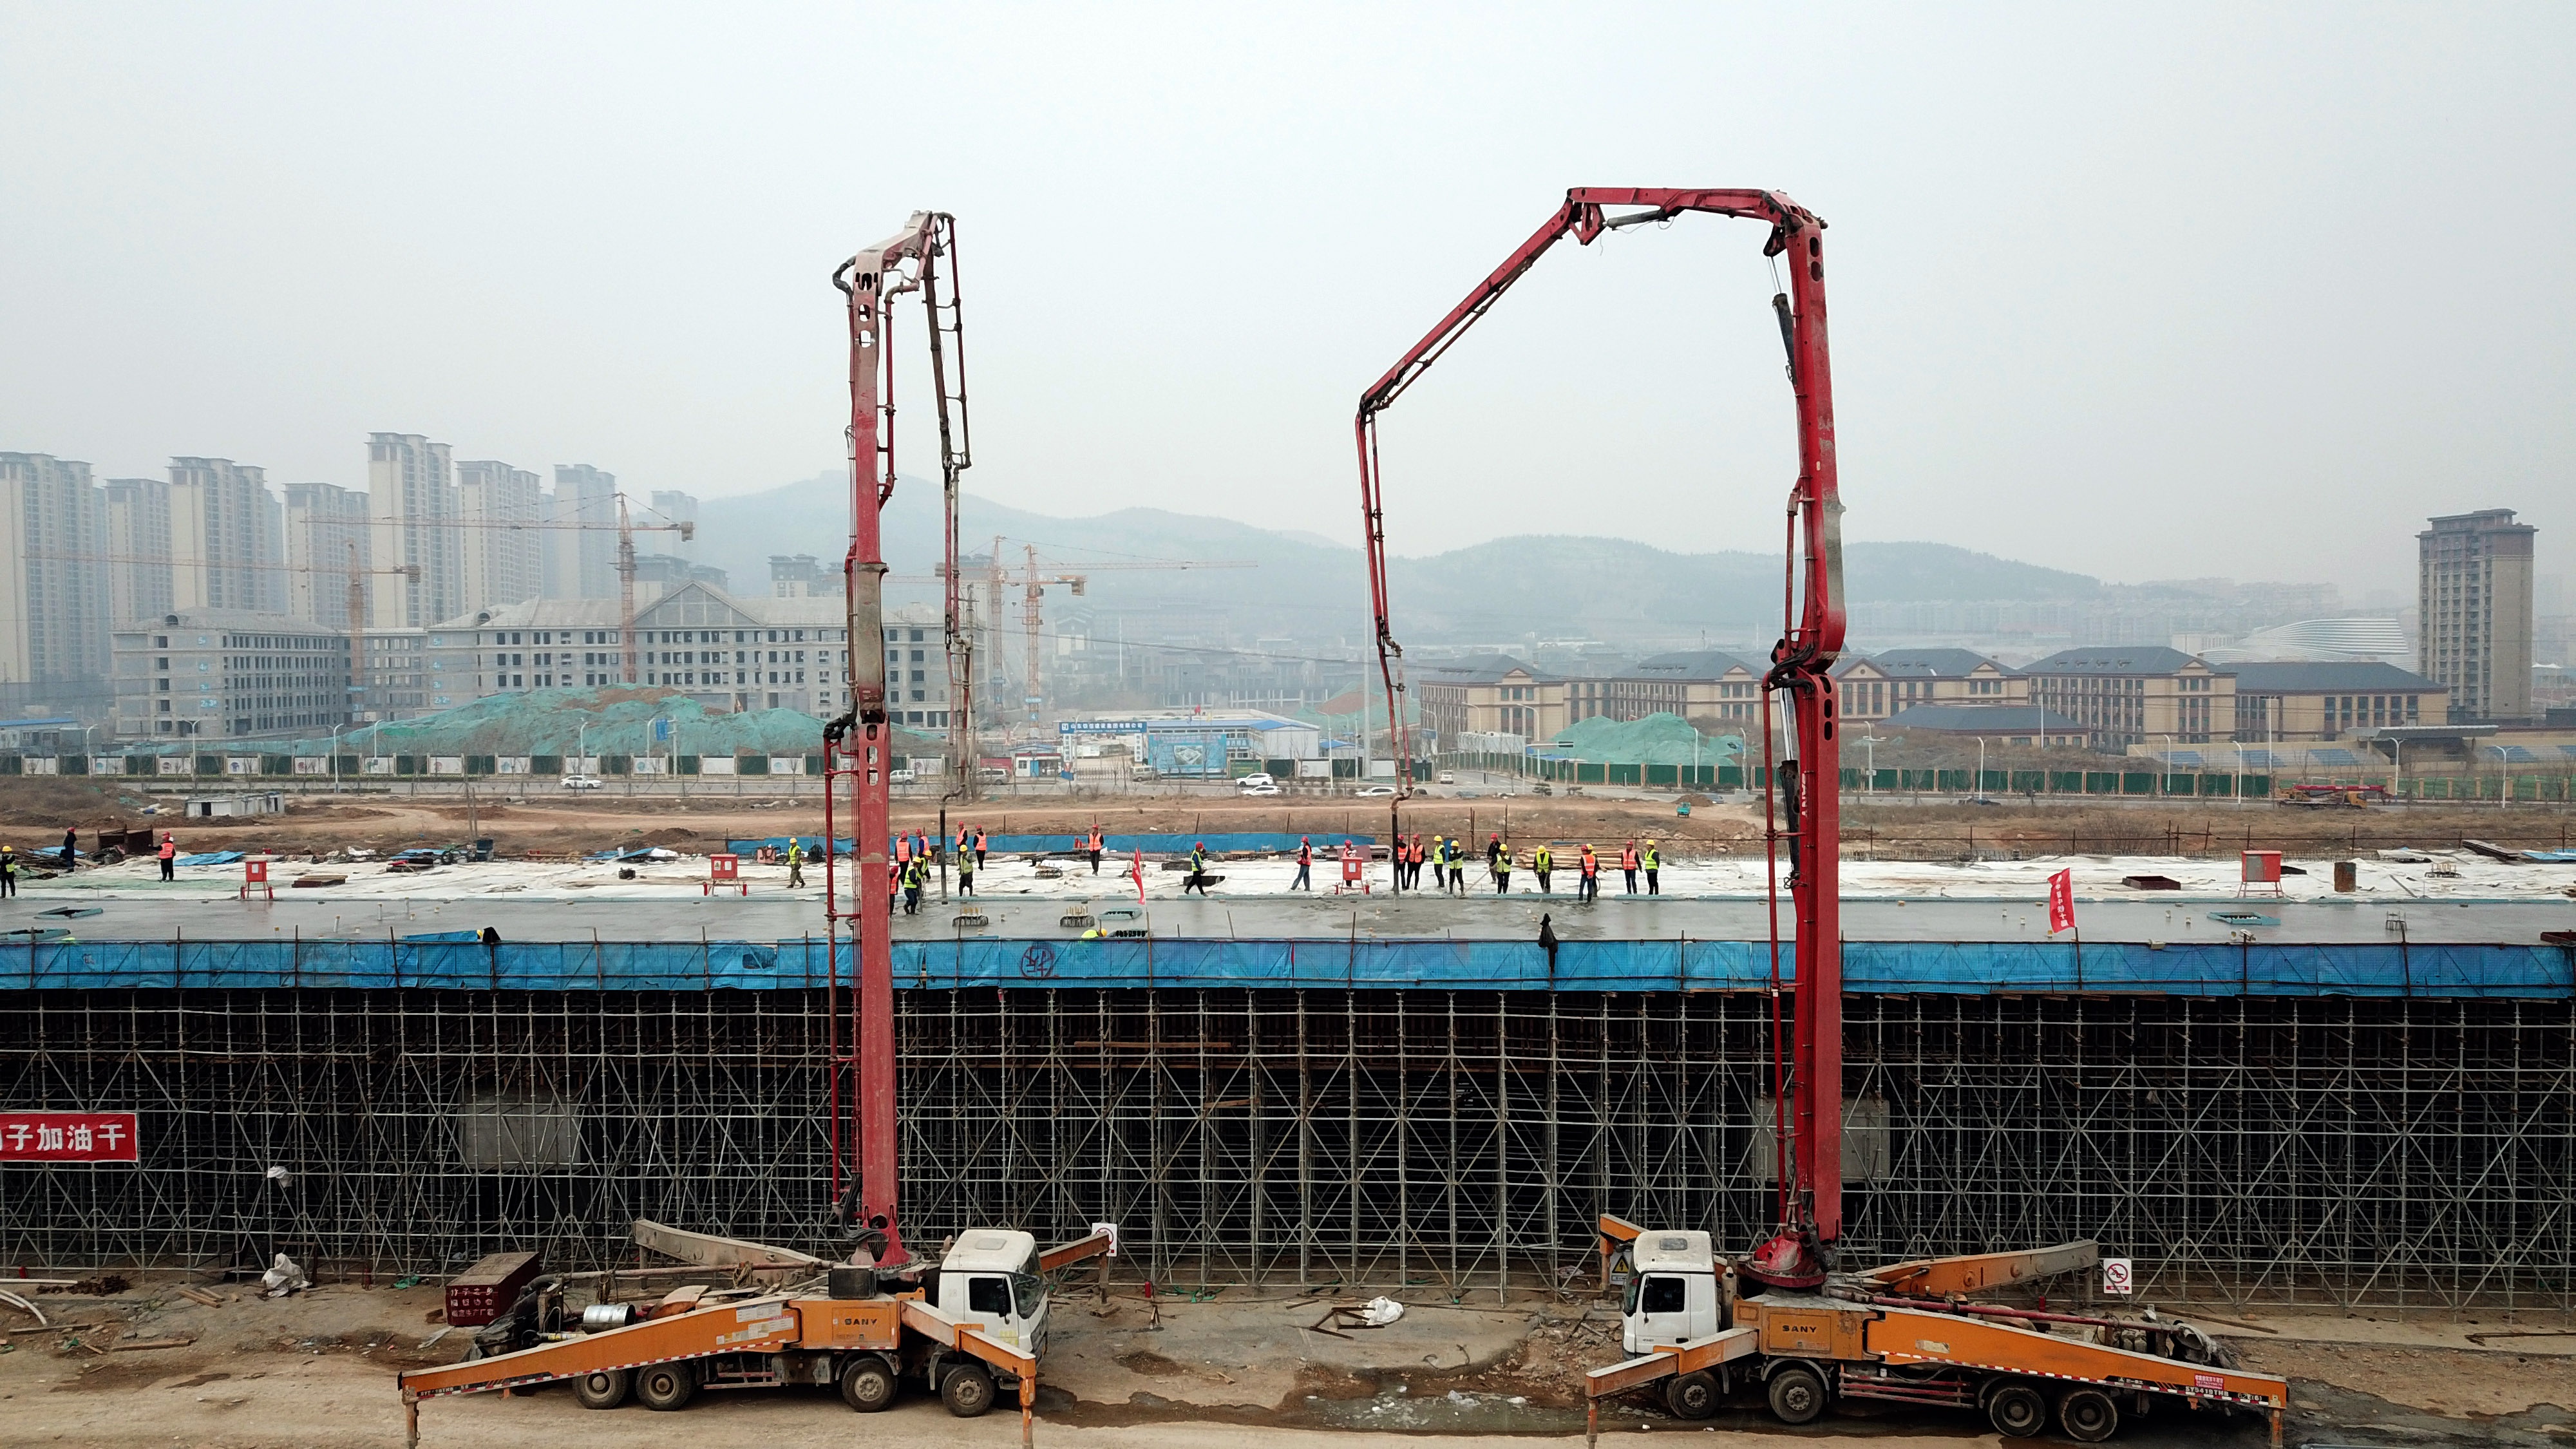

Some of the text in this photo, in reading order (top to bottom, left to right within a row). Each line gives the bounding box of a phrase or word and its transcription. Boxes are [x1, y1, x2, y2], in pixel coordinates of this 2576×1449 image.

[0, 1123, 126, 1151] 子加油干
[2185, 1386, 2229, 1397] SY5419THB
